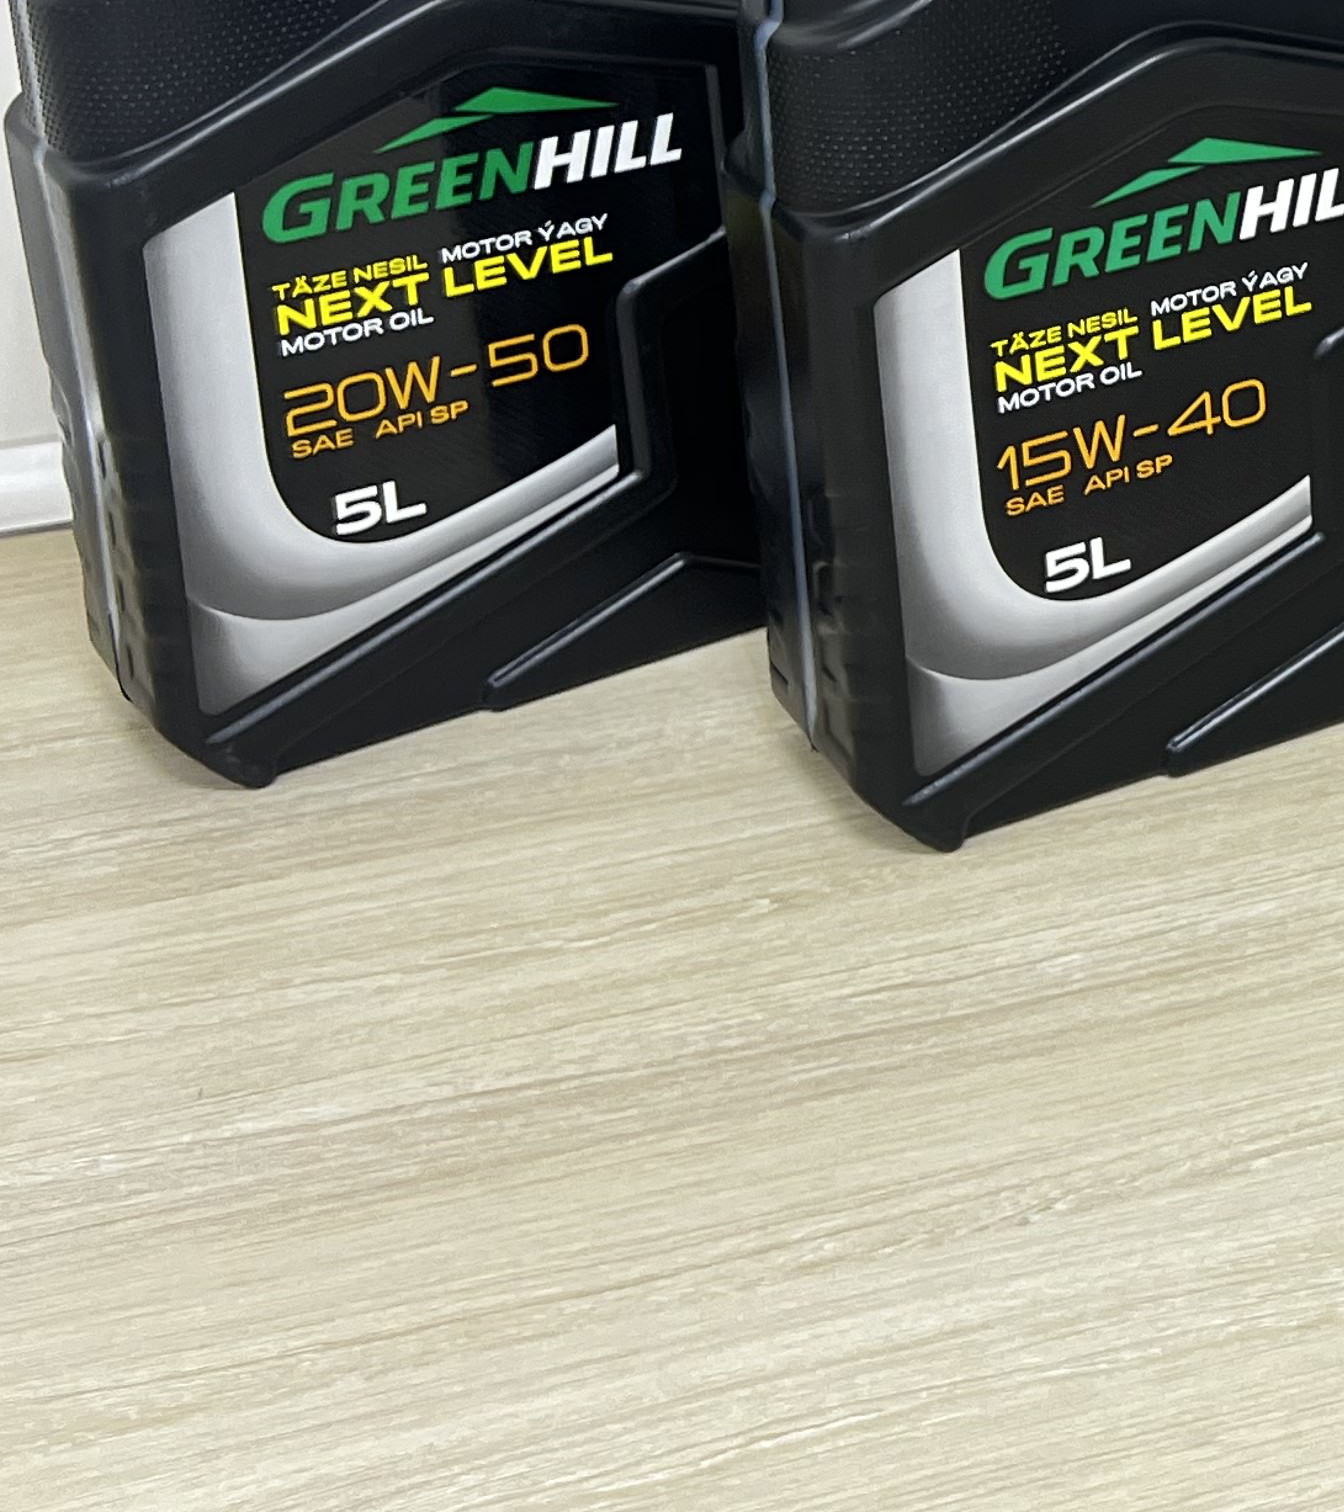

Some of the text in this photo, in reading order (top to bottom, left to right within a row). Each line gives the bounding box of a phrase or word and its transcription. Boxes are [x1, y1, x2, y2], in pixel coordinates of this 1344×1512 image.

[262, 112, 682, 244] GREENHILL
[271, 213, 608, 301] TÄZE NESIL MOTOR ÝAGY
[274, 237, 614, 336] NEXT LEVEL
[280, 308, 434, 357] MOTOR OIL
[990, 262, 1309, 357] TÄZE NESIL MOTOR ÝAGY
[993, 287, 1312, 393] NEXT LEVEL
[283, 323, 590, 437] 20W-50
[997, 361, 1143, 414] MOTOR OIL
[291, 400, 469, 459] SAE API SP
[997, 378, 1267, 491] 15W-40
[334, 480, 427, 536] 5L
[1005, 454, 1173, 516] SAE API SP
[1044, 536, 1131, 594] 5L
